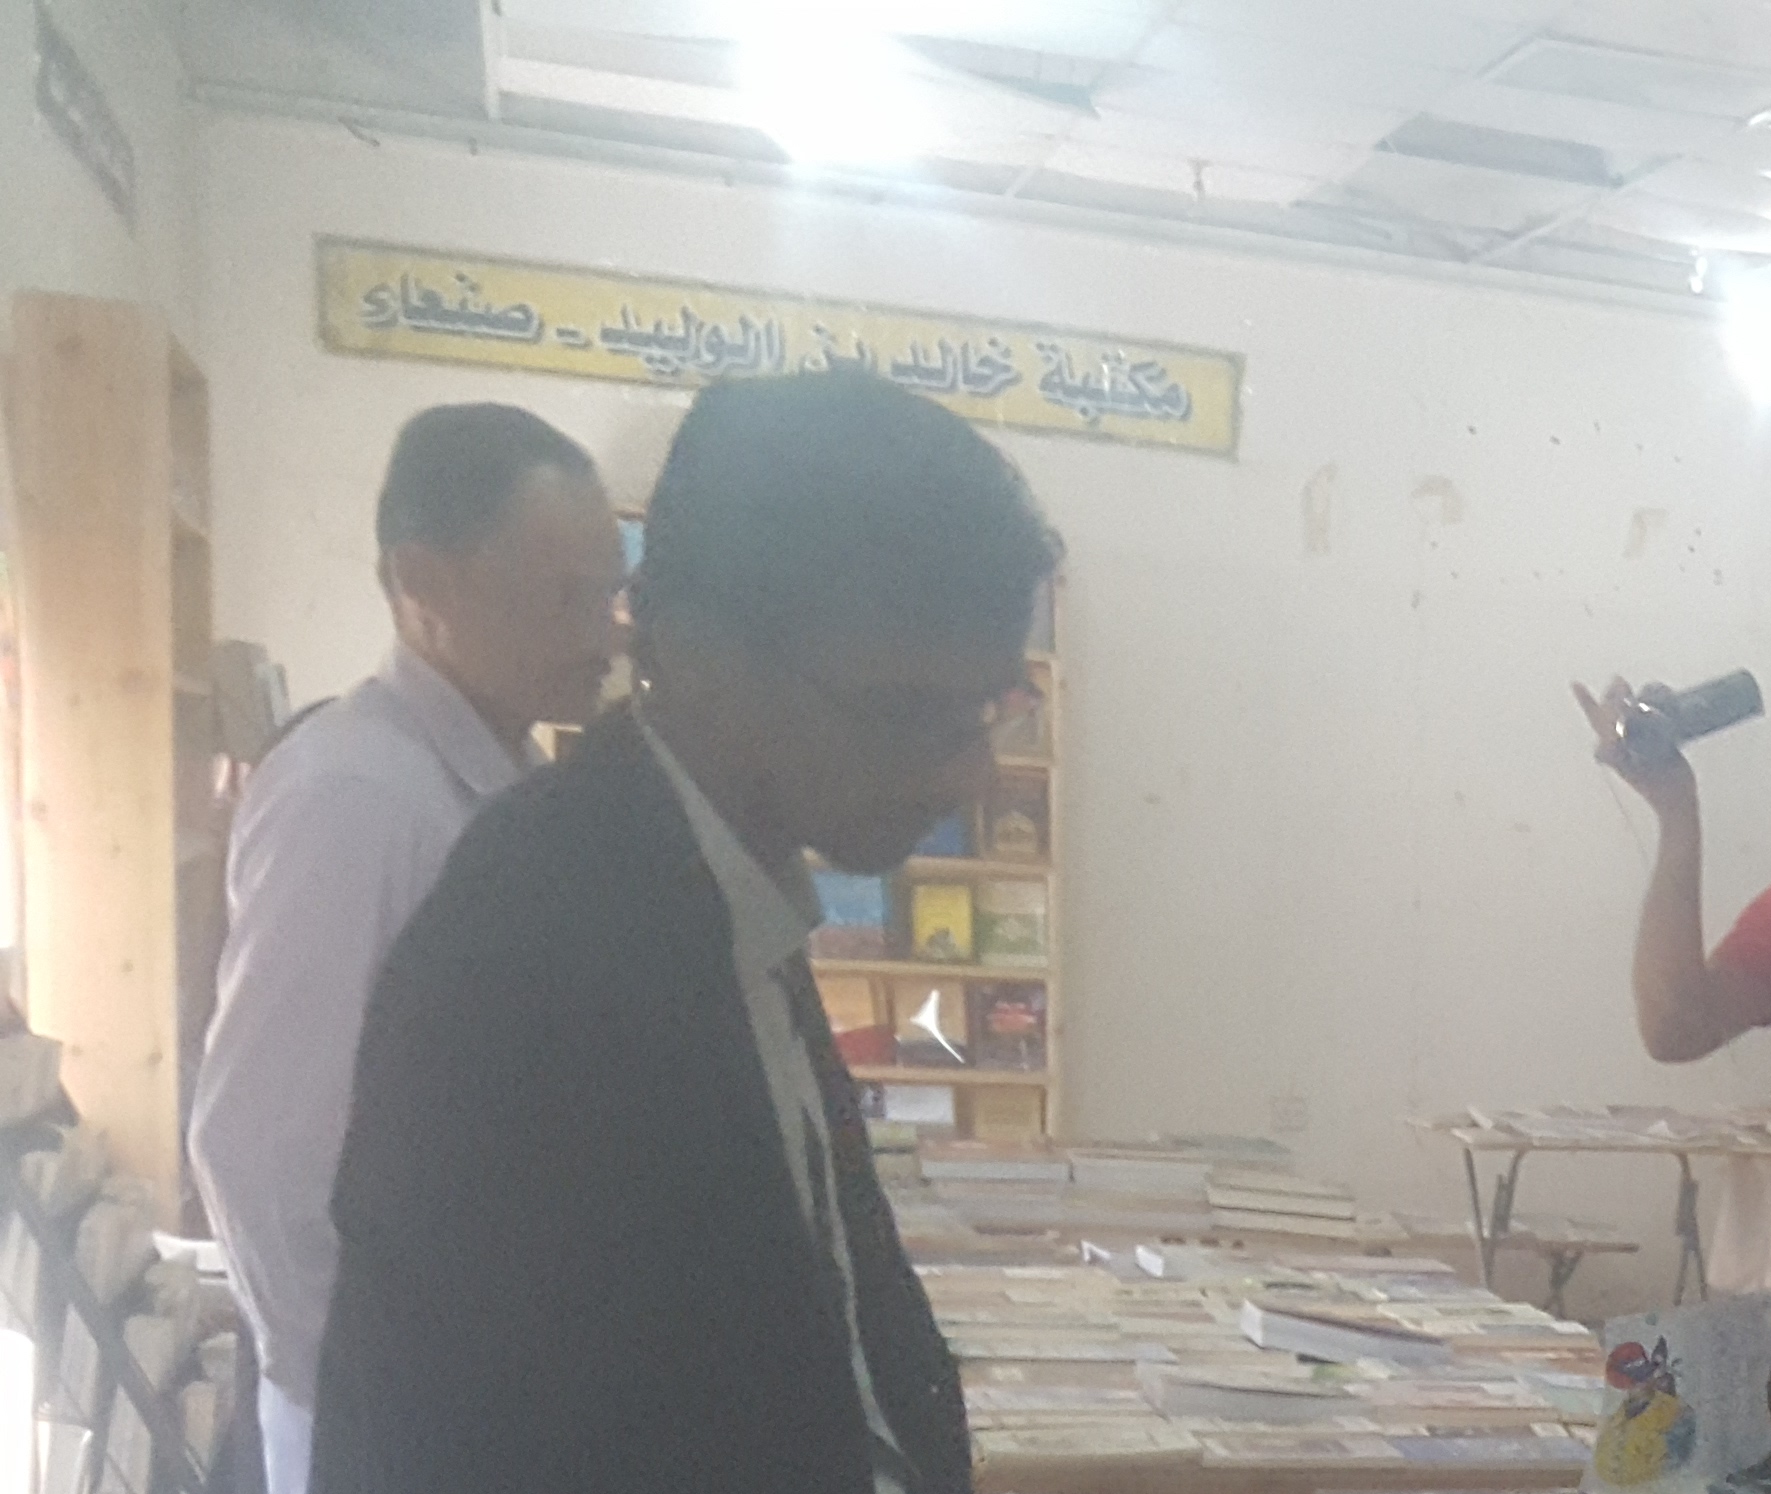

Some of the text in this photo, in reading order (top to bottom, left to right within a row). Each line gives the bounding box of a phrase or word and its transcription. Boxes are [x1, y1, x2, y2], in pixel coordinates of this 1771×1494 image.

[360, 272, 545, 344] صنعاء
[600, 303, 787, 378] الوليد
[891, 334, 1023, 395] خالد
[1034, 338, 1193, 424] مكتبة
